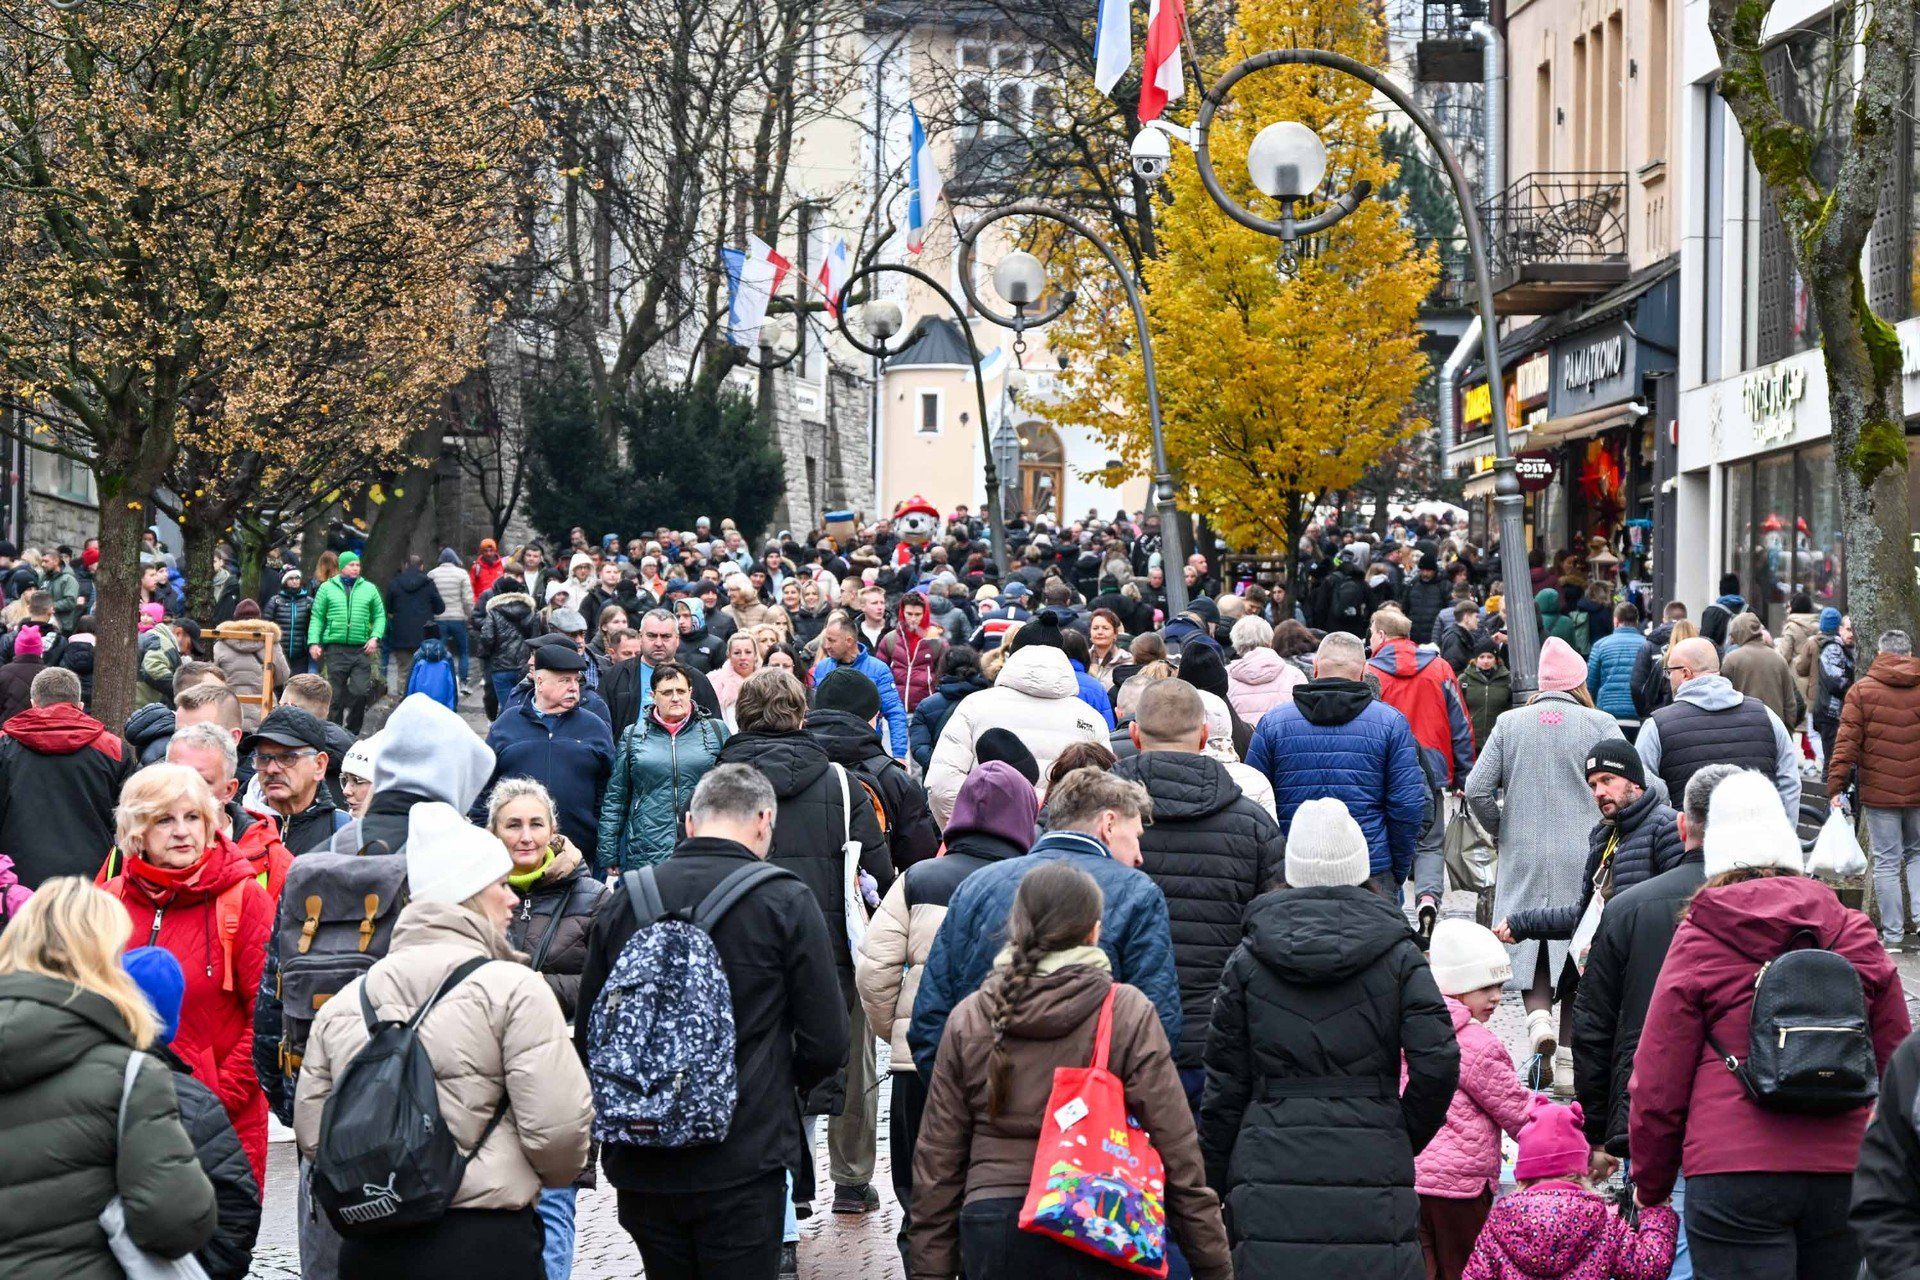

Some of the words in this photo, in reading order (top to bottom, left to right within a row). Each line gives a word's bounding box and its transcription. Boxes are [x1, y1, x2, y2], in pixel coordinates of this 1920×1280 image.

[1565, 335, 1622, 393] PAMIĄTKOWO
[1515, 462, 1552, 473] COSTA
[339, 1196, 397, 1224] PUMA
